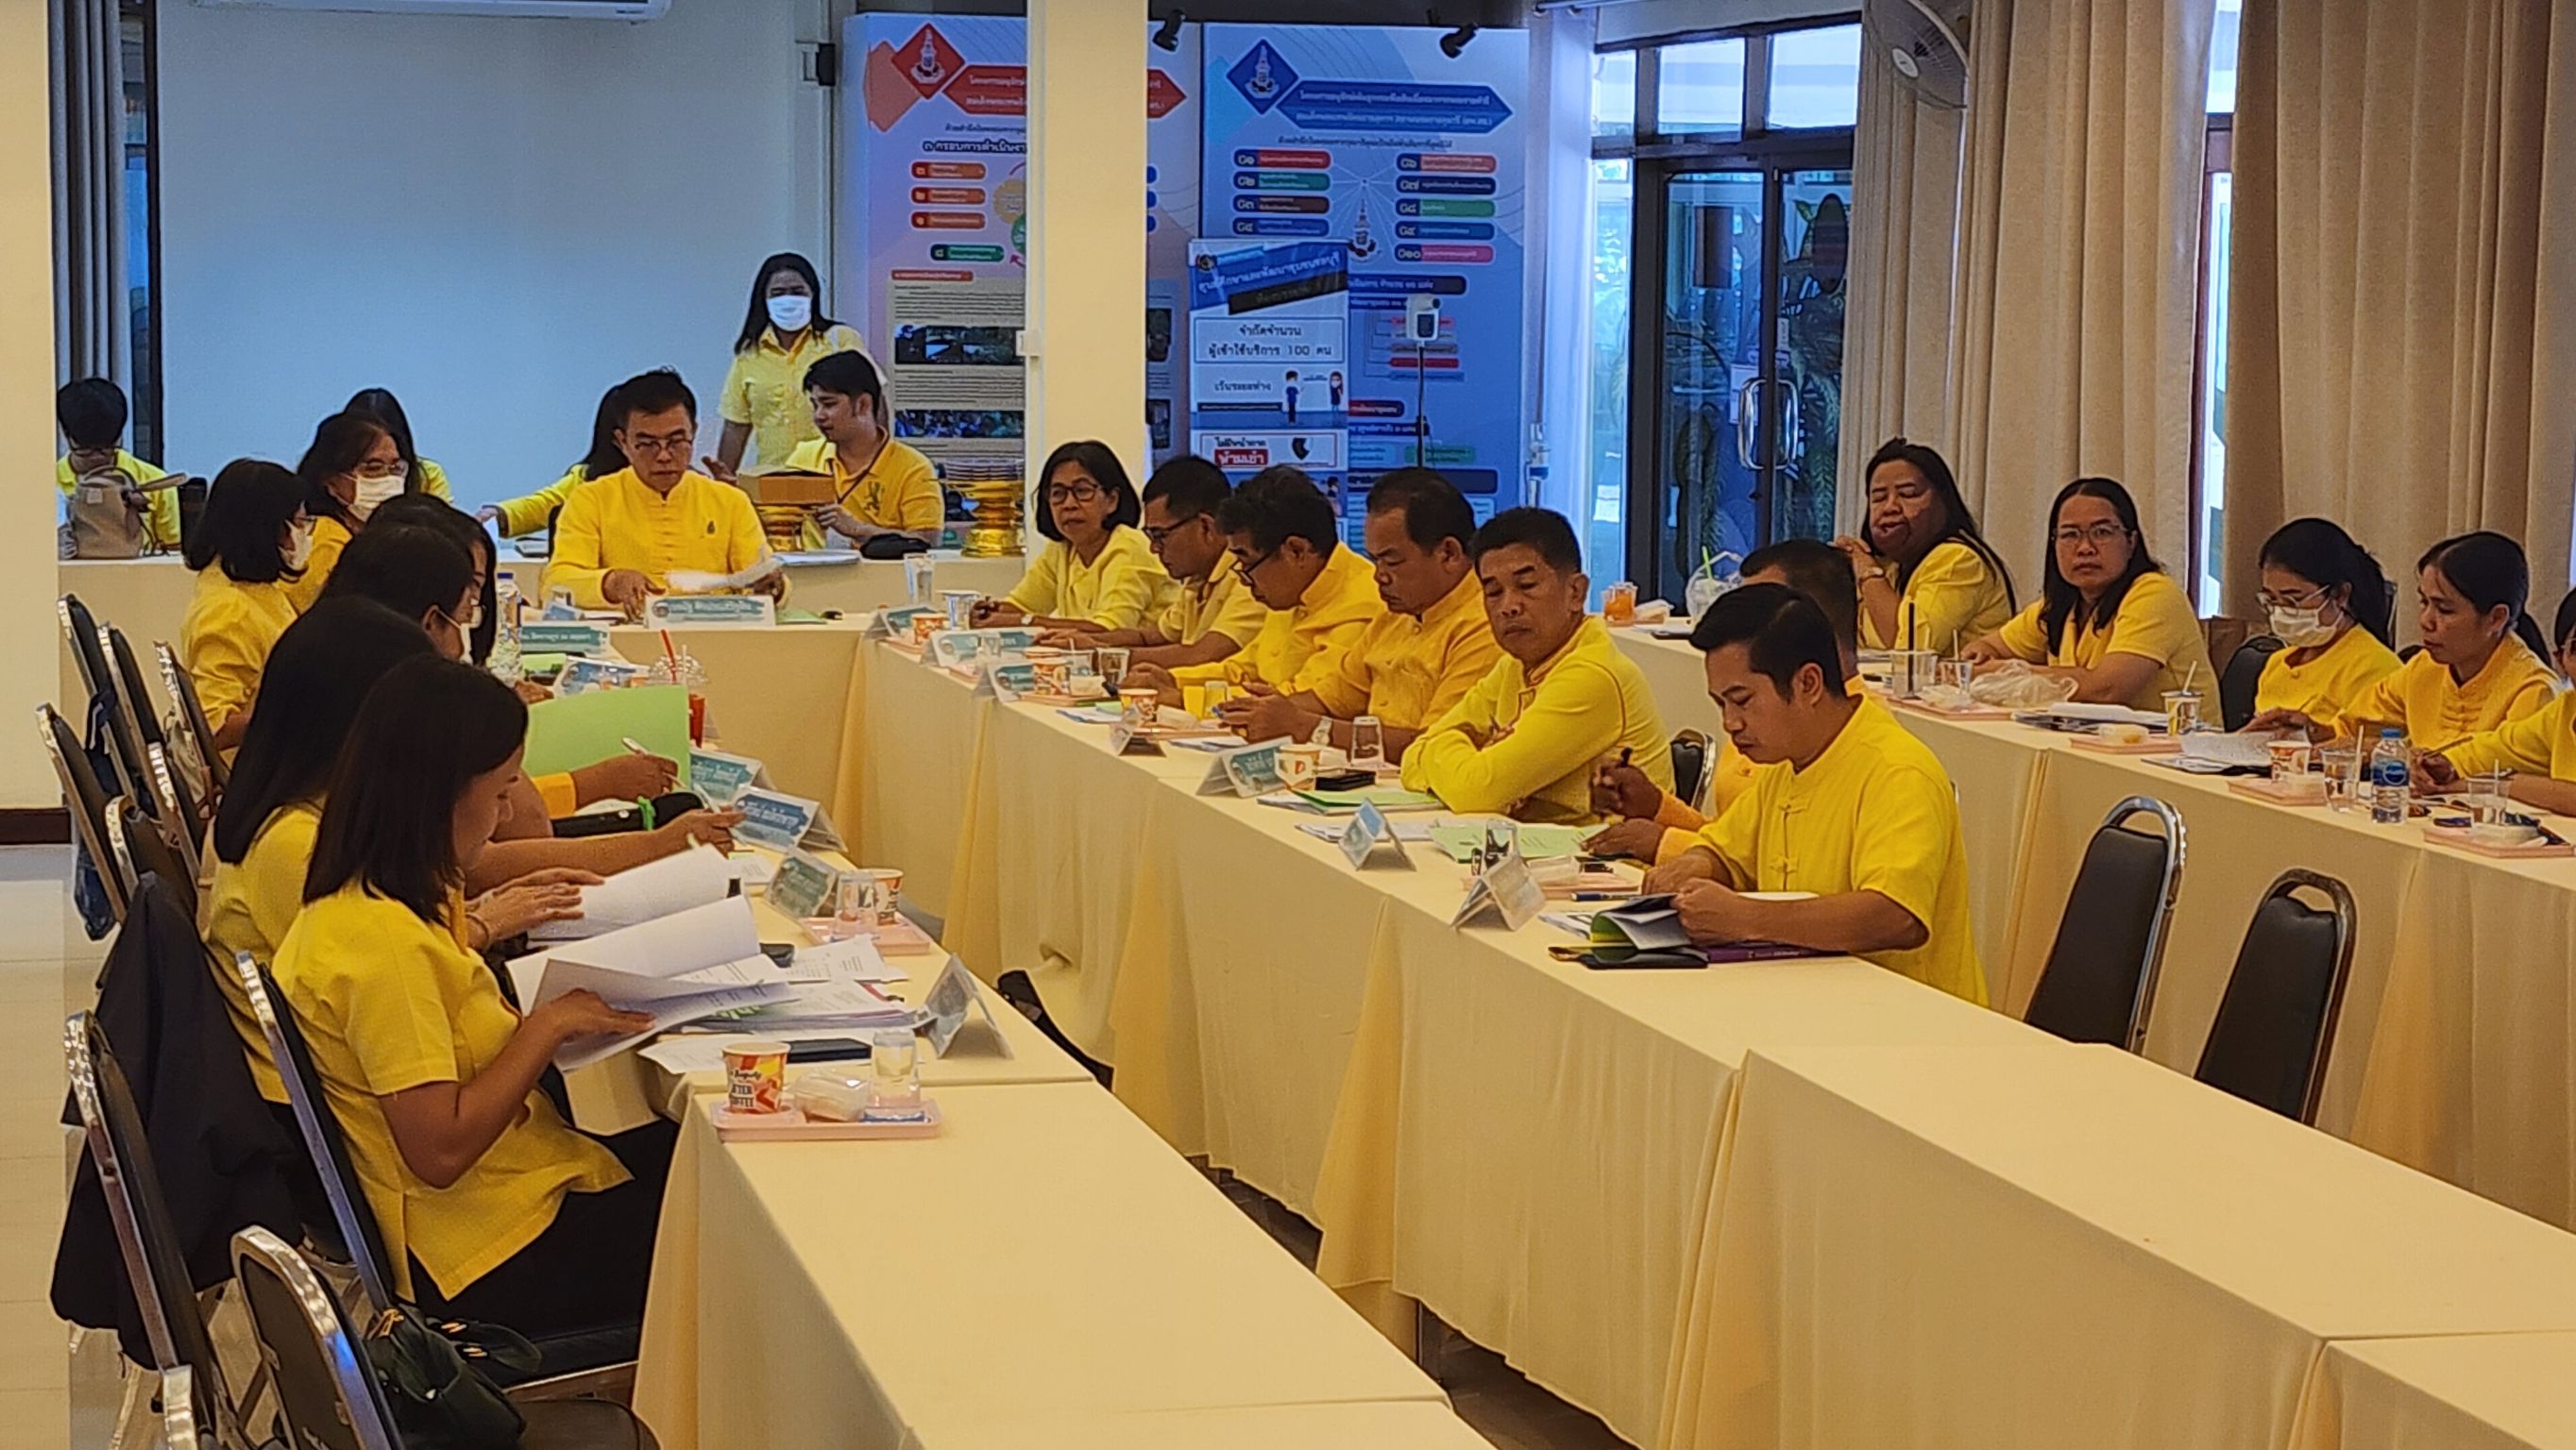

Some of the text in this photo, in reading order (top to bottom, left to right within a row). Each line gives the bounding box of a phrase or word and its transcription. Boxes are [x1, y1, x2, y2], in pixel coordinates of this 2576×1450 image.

[1239, 324, 1301, 336] จำกัดจำนวน
[1209, 343, 1332, 358] ผู้เข้าใช้บริการ 100 คน
[1218, 450, 1264, 465] ห้ามเข้า
